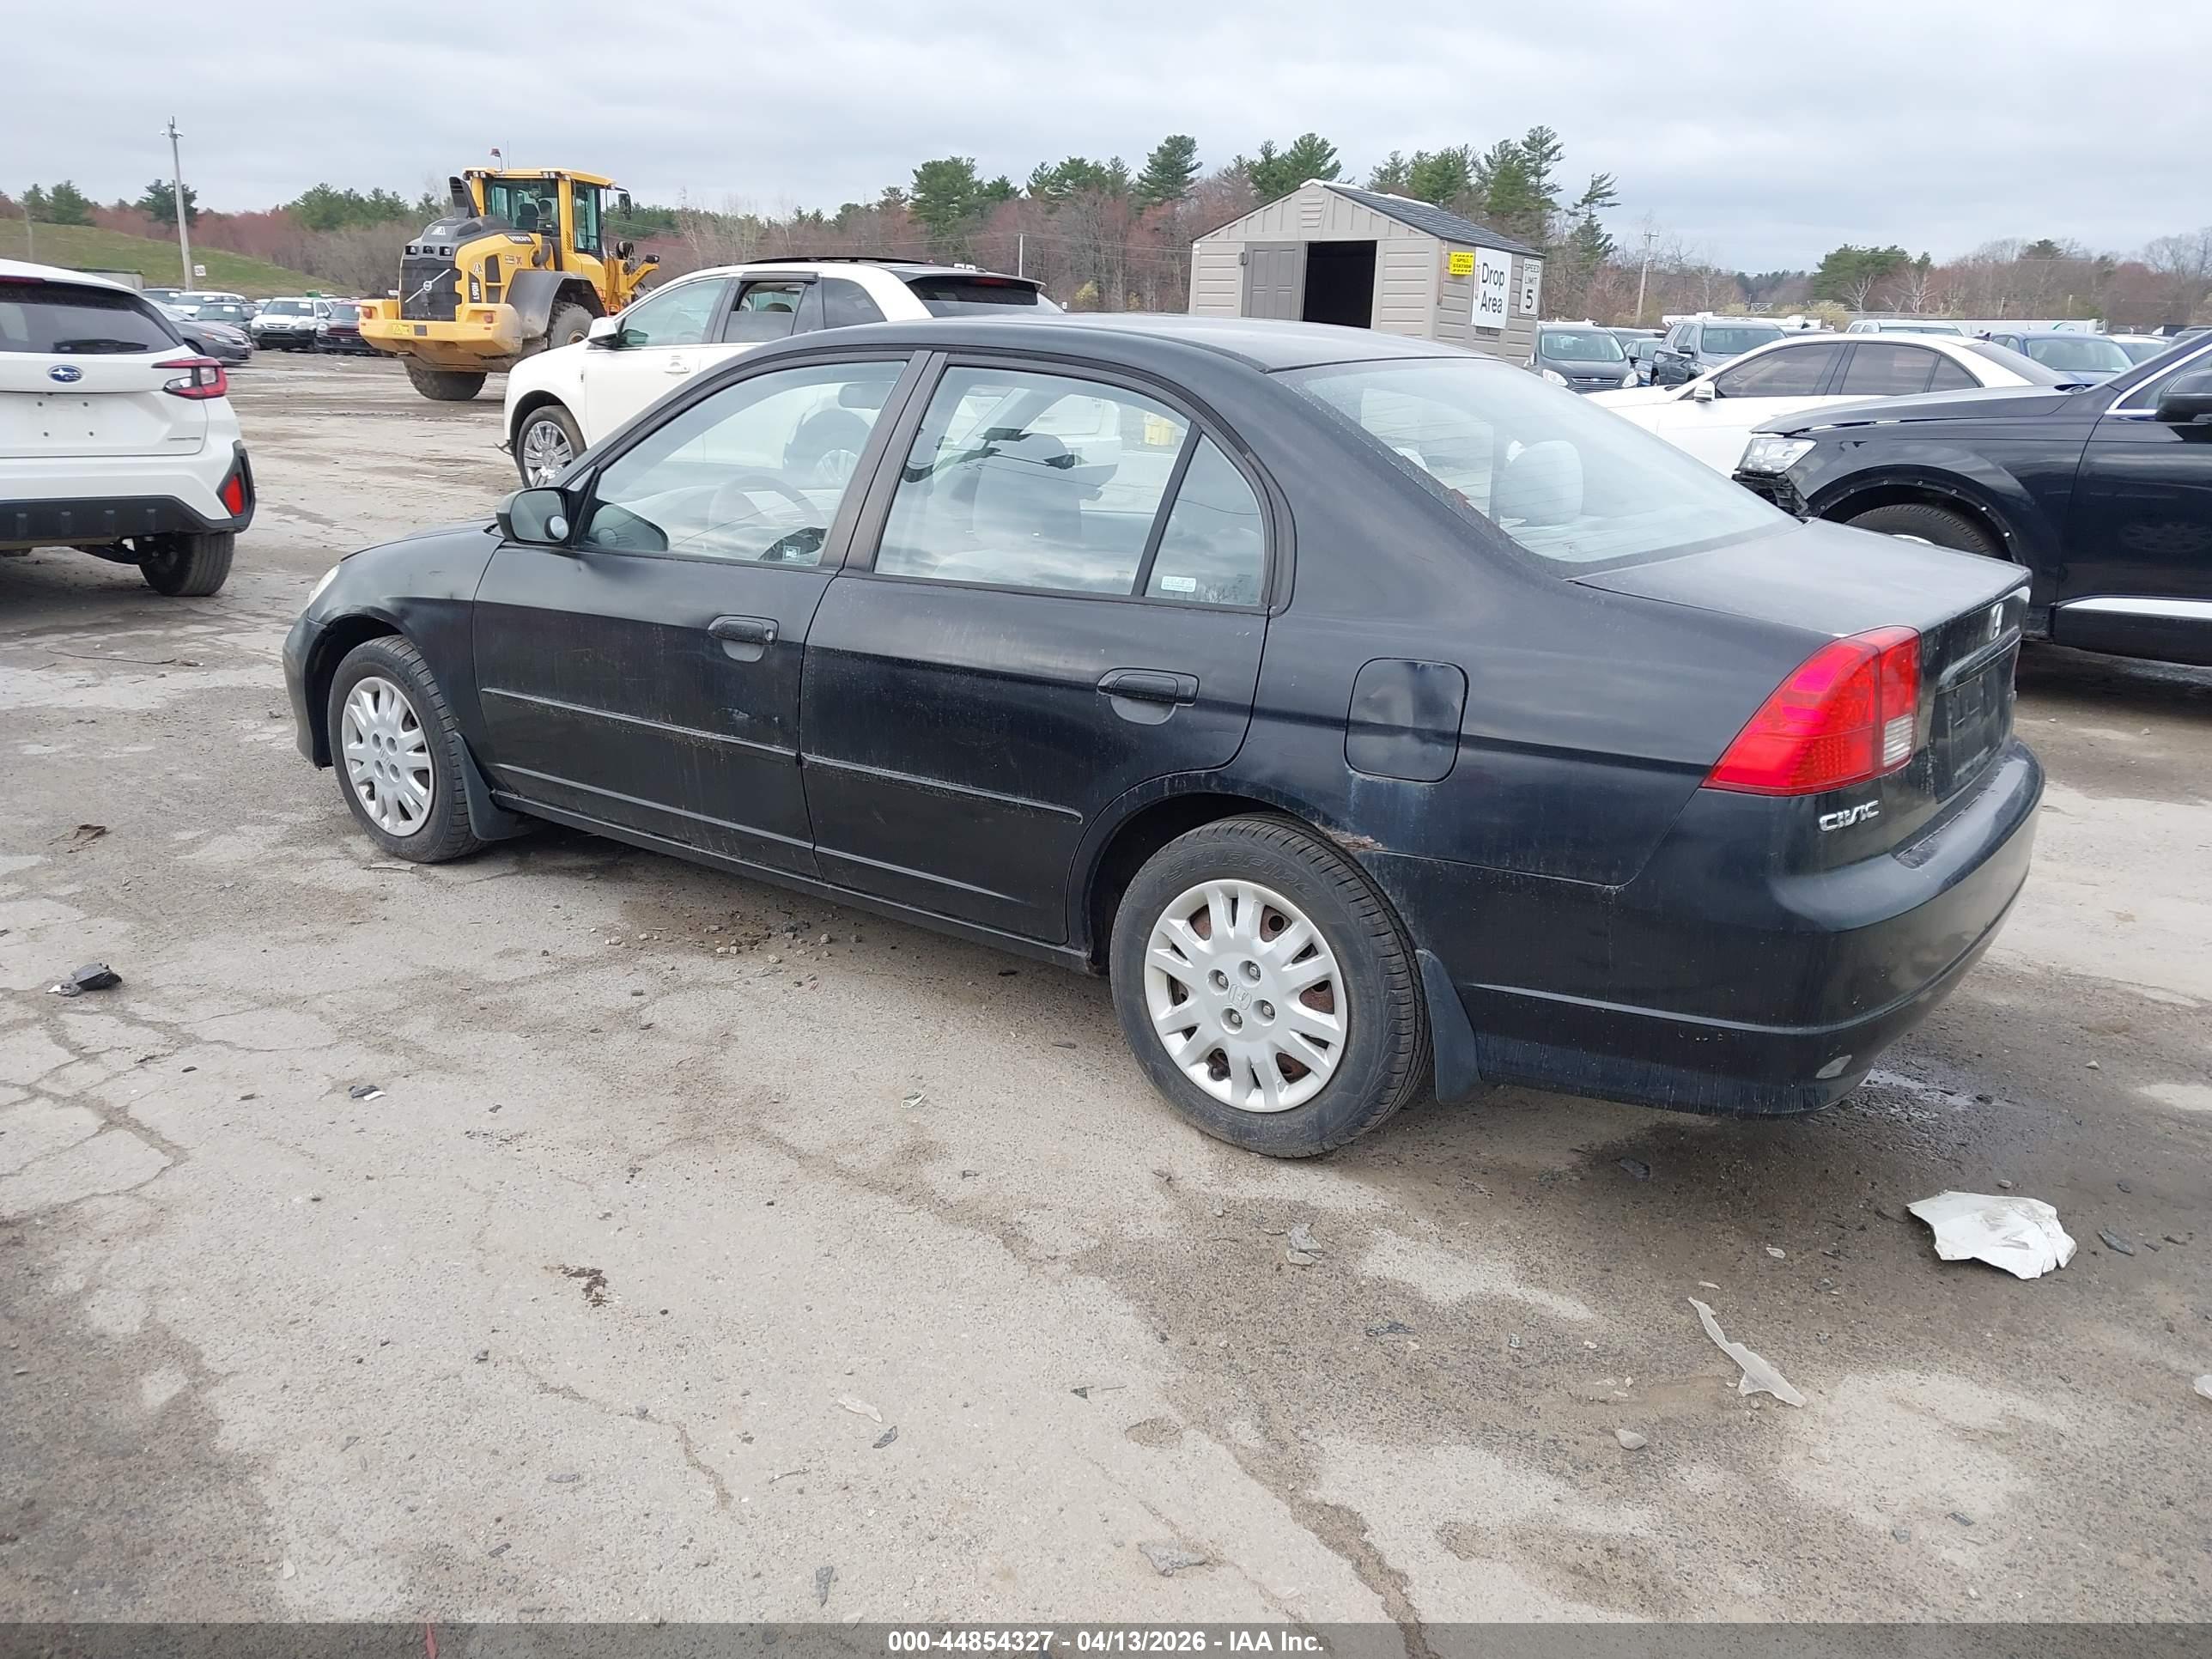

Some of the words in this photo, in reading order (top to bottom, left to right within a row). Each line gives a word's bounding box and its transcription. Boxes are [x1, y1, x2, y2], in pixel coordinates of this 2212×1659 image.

[1481, 262, 1505, 290] Drop
[1524, 263, 1540, 273] SPEED
[1524, 276, 1538, 285] LIMIT
[1480, 290, 1503, 313] Area
[1525, 289, 1534, 310] 5
[1820, 799, 1880, 831] CIVIC
